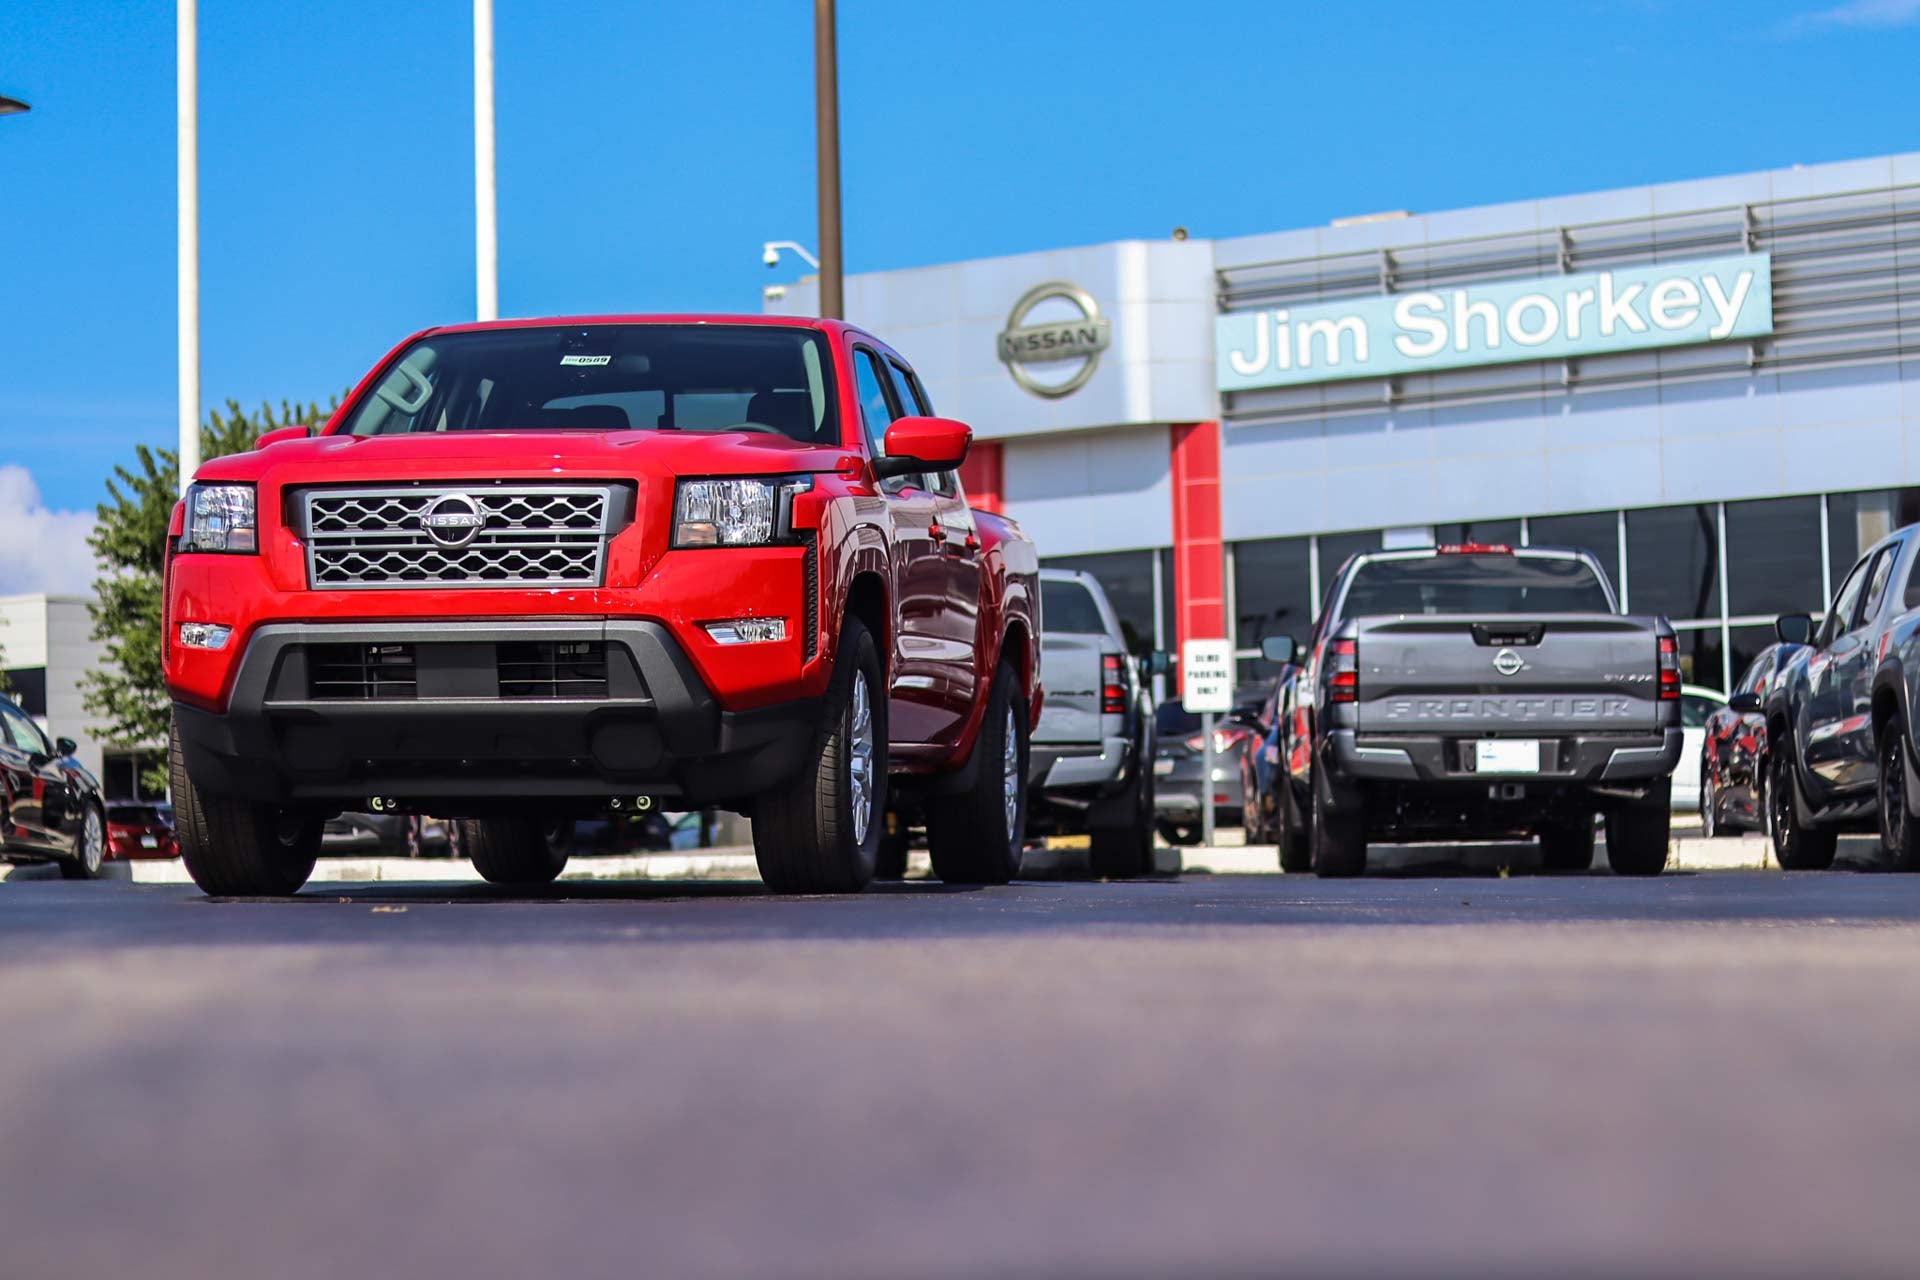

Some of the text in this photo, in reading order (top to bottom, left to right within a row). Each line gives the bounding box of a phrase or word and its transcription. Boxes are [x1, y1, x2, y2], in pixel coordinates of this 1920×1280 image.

[1230, 270, 1755, 376] Jim Shorkey
[422, 517, 483, 526] NISSAN
[1195, 654, 1220, 663] DEMO
[1187, 670, 1228, 679] PARKING
[1197, 686, 1218, 695] ONLY
[1386, 701, 1630, 718] FRONTIER
